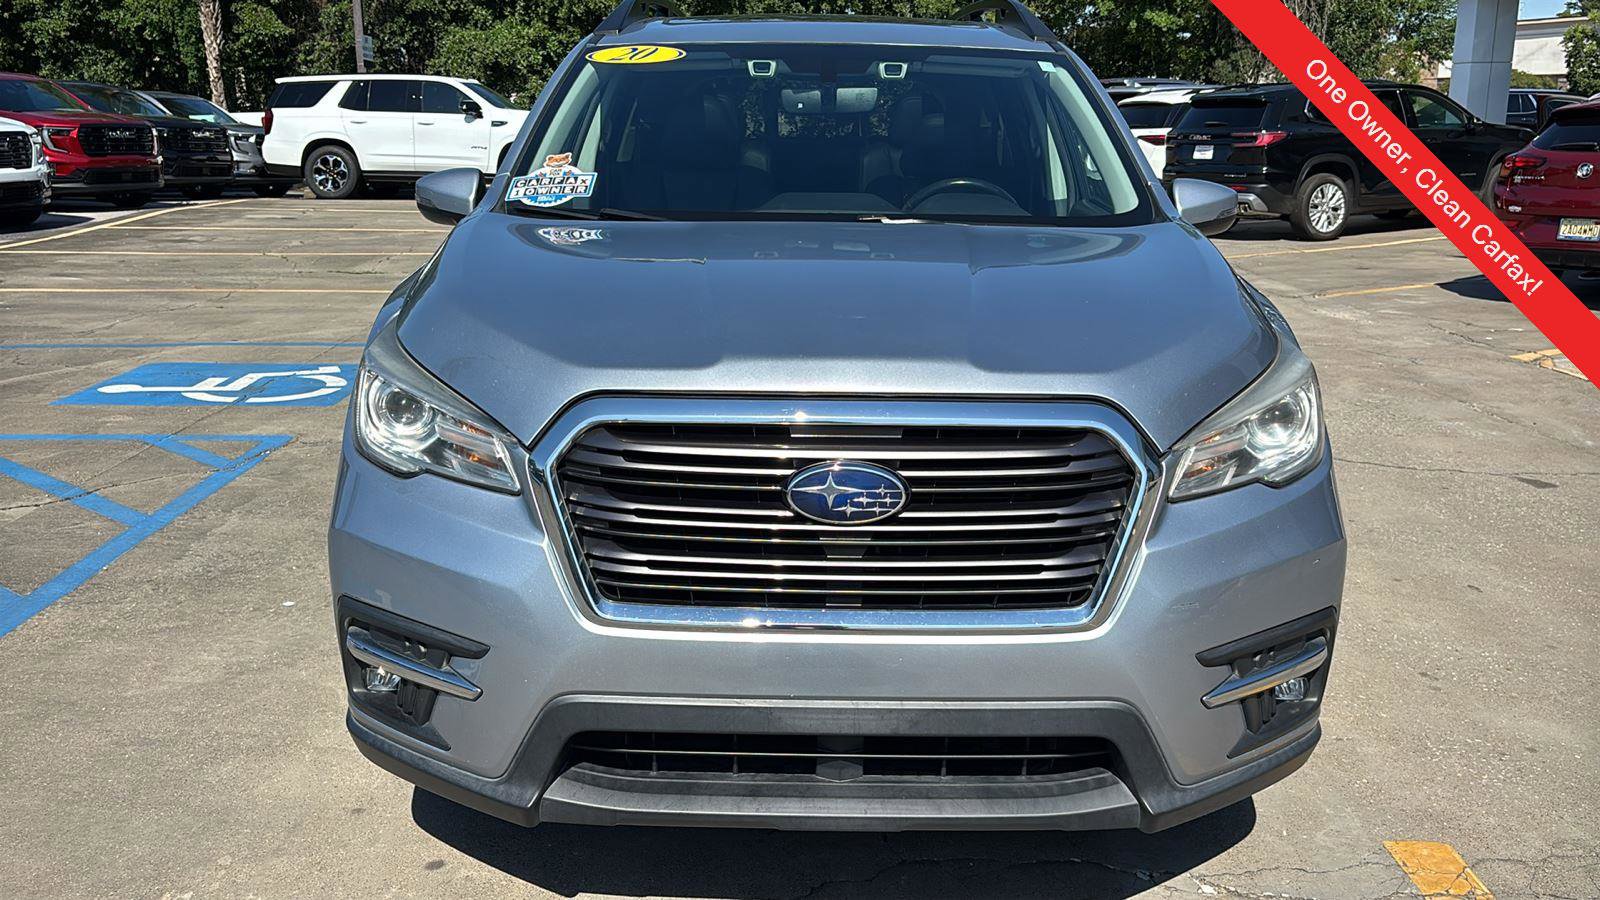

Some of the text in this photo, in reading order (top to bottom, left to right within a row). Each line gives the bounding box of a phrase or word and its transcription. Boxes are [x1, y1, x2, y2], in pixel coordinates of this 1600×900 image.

[606, 47, 659, 61] 20
[516, 176, 589, 188] CARFAX
[525, 185, 586, 196] OWNER
